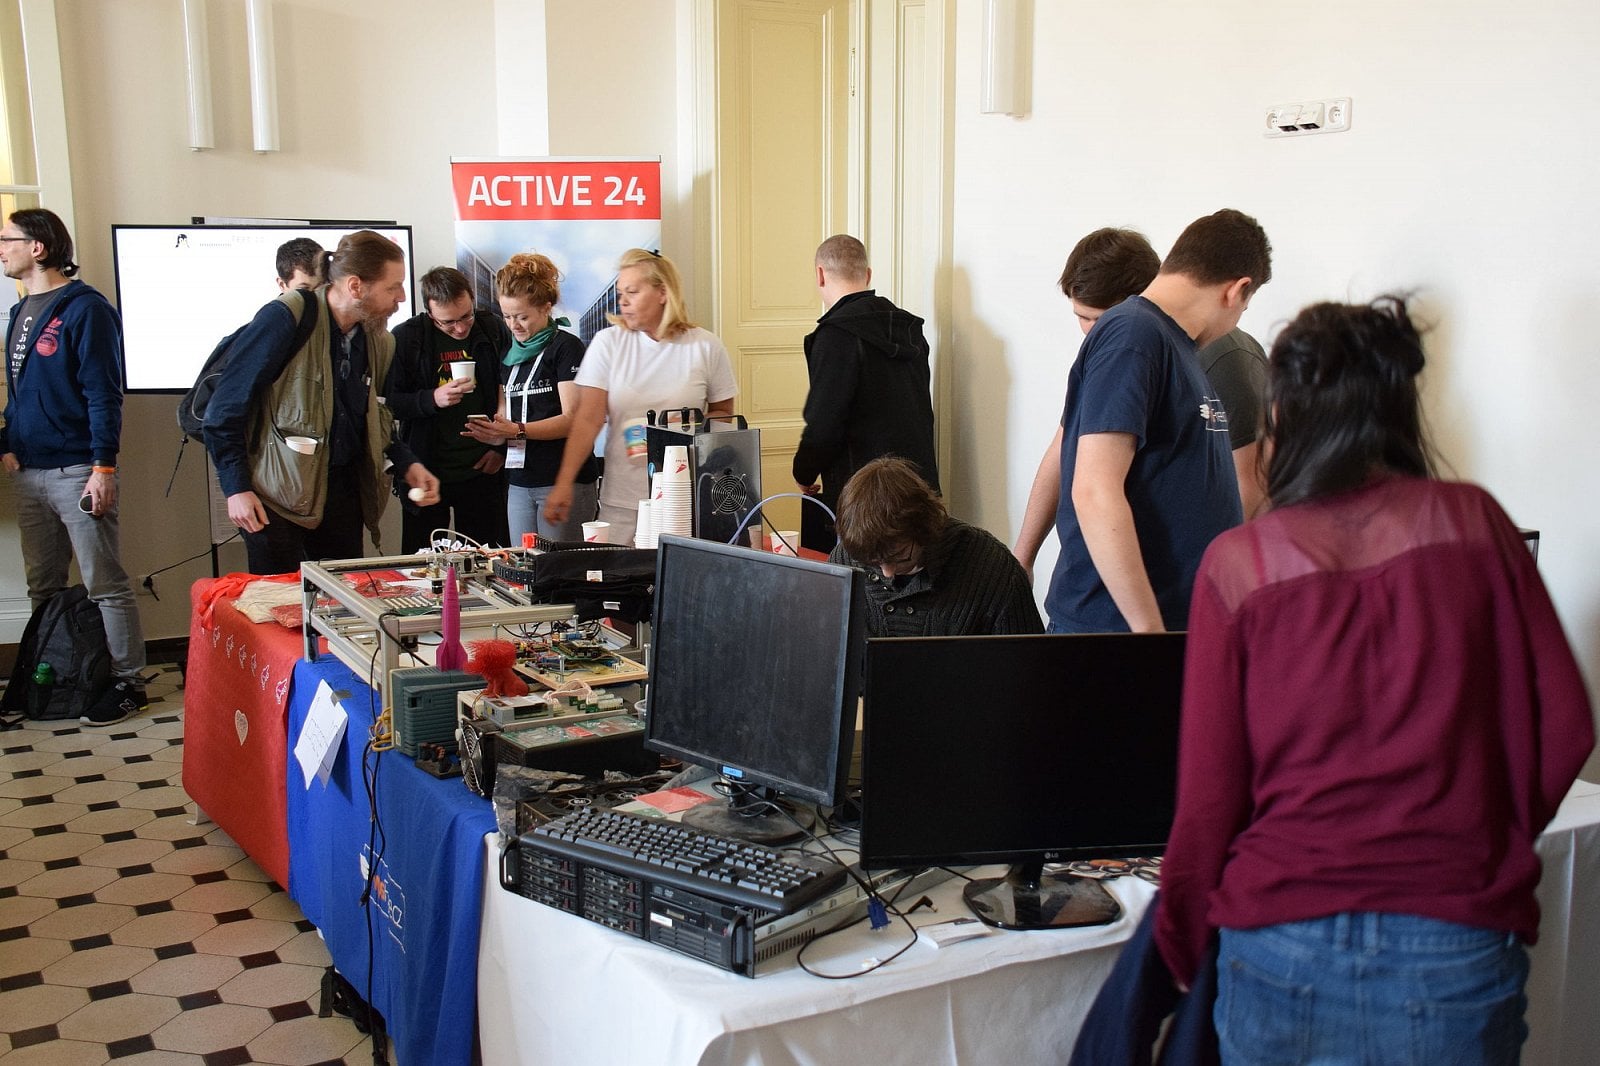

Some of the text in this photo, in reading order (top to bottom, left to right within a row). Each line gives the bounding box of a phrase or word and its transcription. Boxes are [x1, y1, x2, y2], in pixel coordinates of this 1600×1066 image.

[467, 175, 646, 207] ACTIVE 24
[440, 350, 463, 361] LINUX
